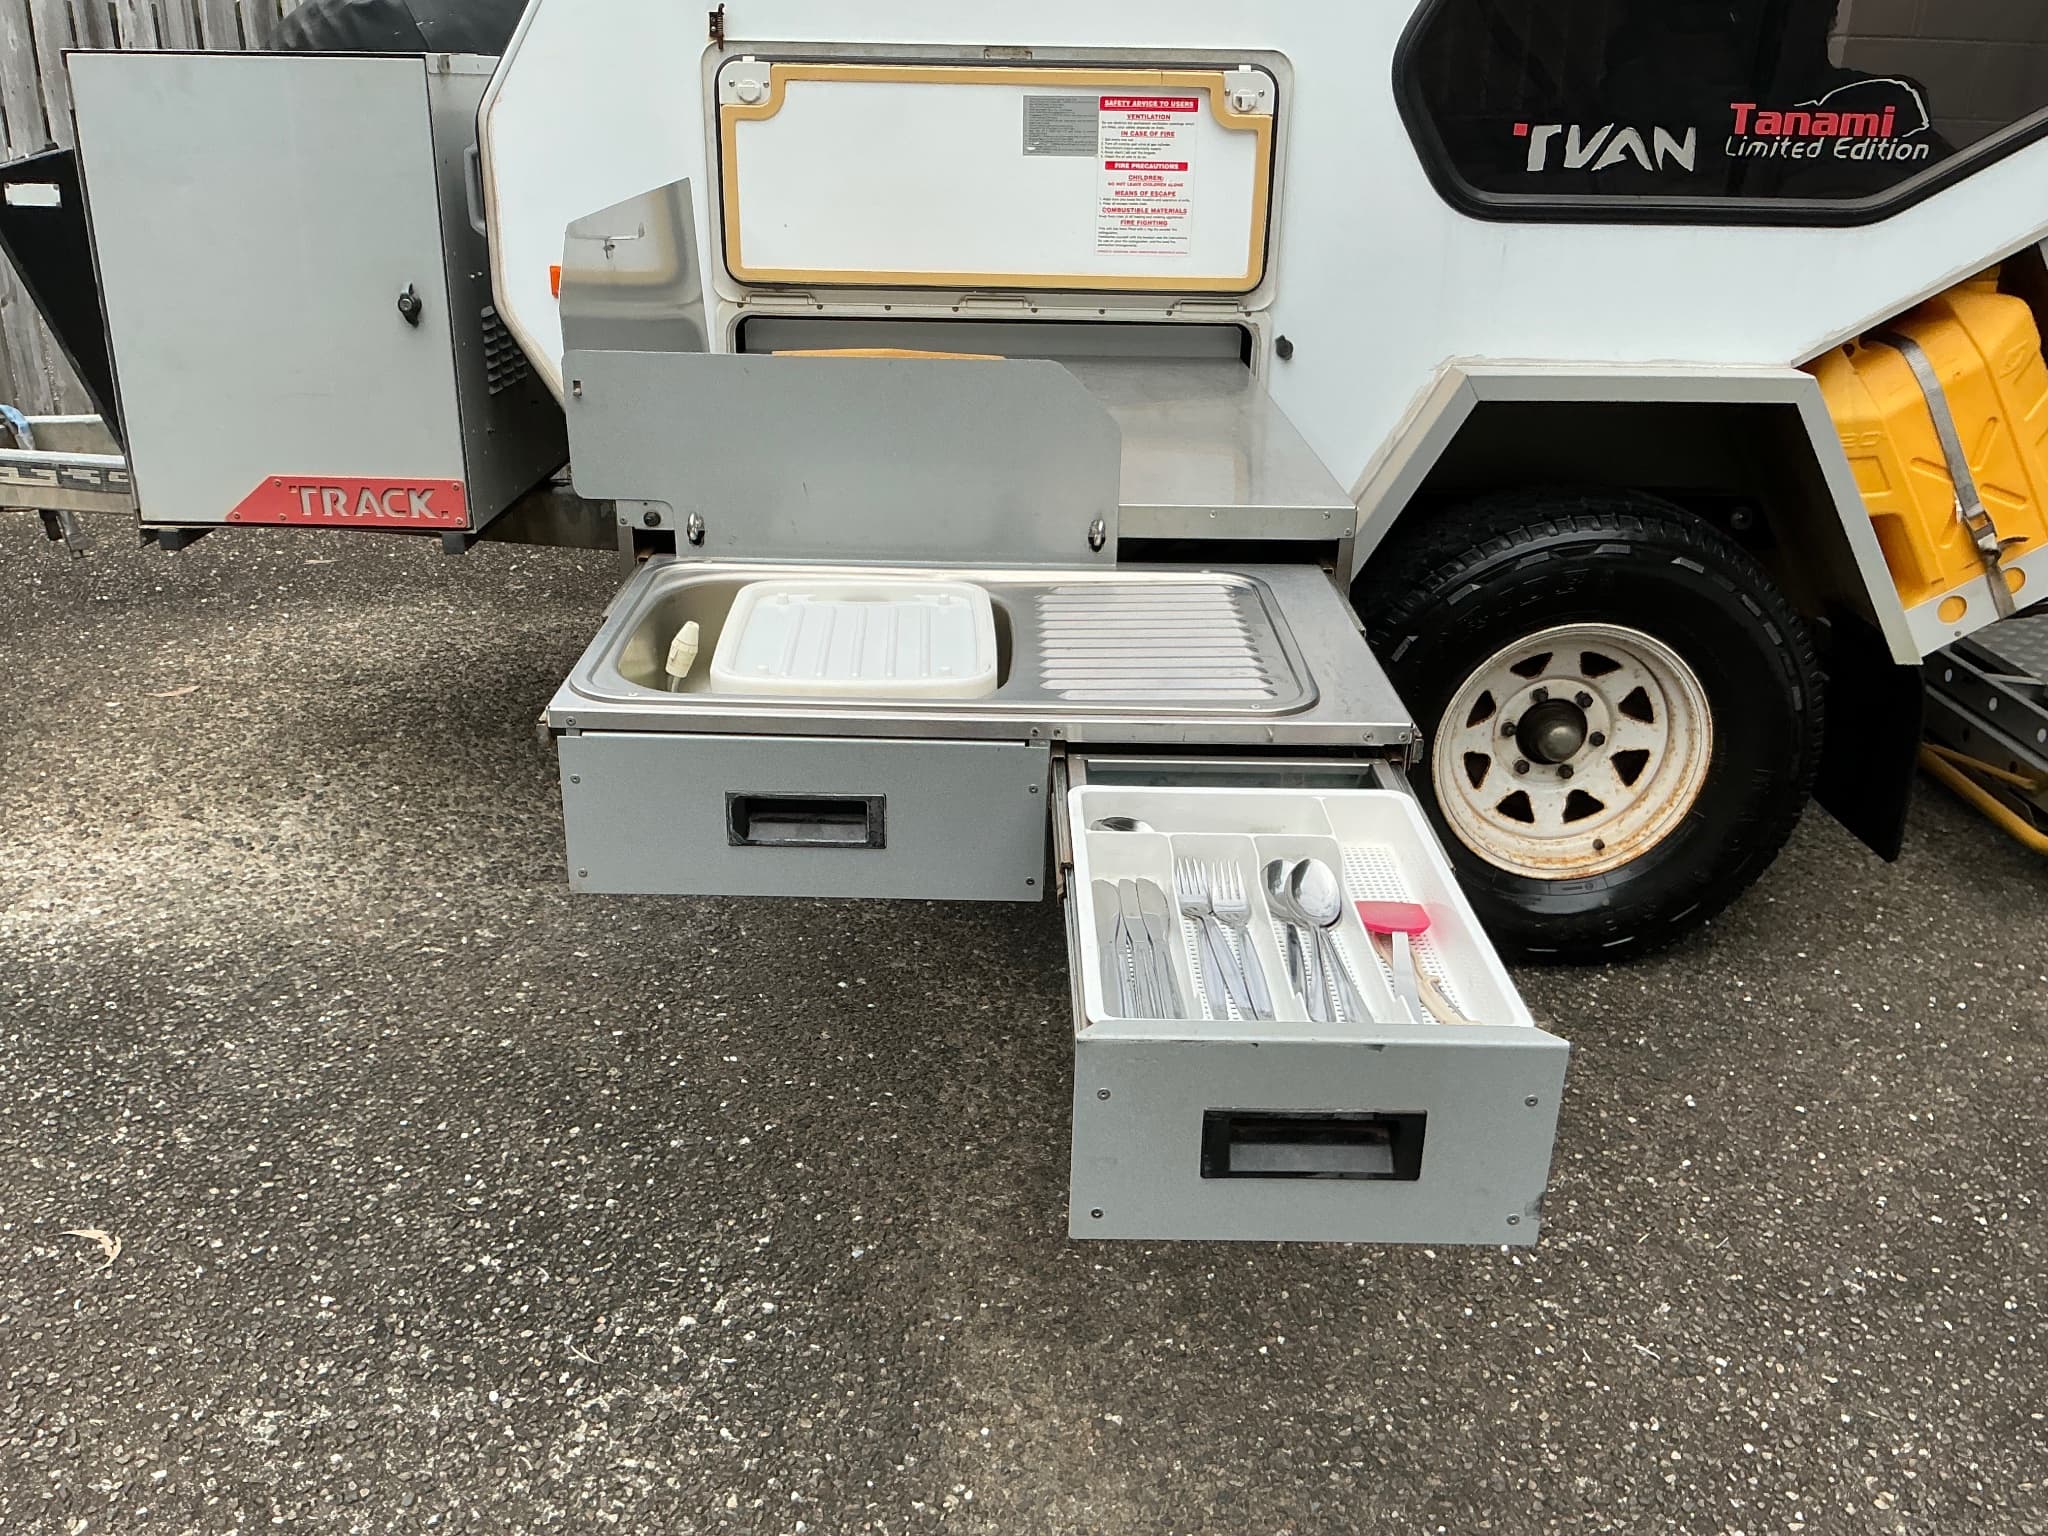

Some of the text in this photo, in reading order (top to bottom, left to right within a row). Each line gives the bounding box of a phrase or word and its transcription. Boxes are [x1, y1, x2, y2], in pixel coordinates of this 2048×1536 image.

[1104, 99, 1130, 107] SAFETY
[1132, 100, 1157, 108] ADVICE
[1159, 100, 1169, 108] TO
[1126, 113, 1171, 121] VENTILATION
[1730, 103, 1896, 138] Tanami
[1725, 135, 1930, 162] Limited Edition
[1150, 207, 1188, 215] MATERIALS
[289, 486, 442, 519] TRACK
